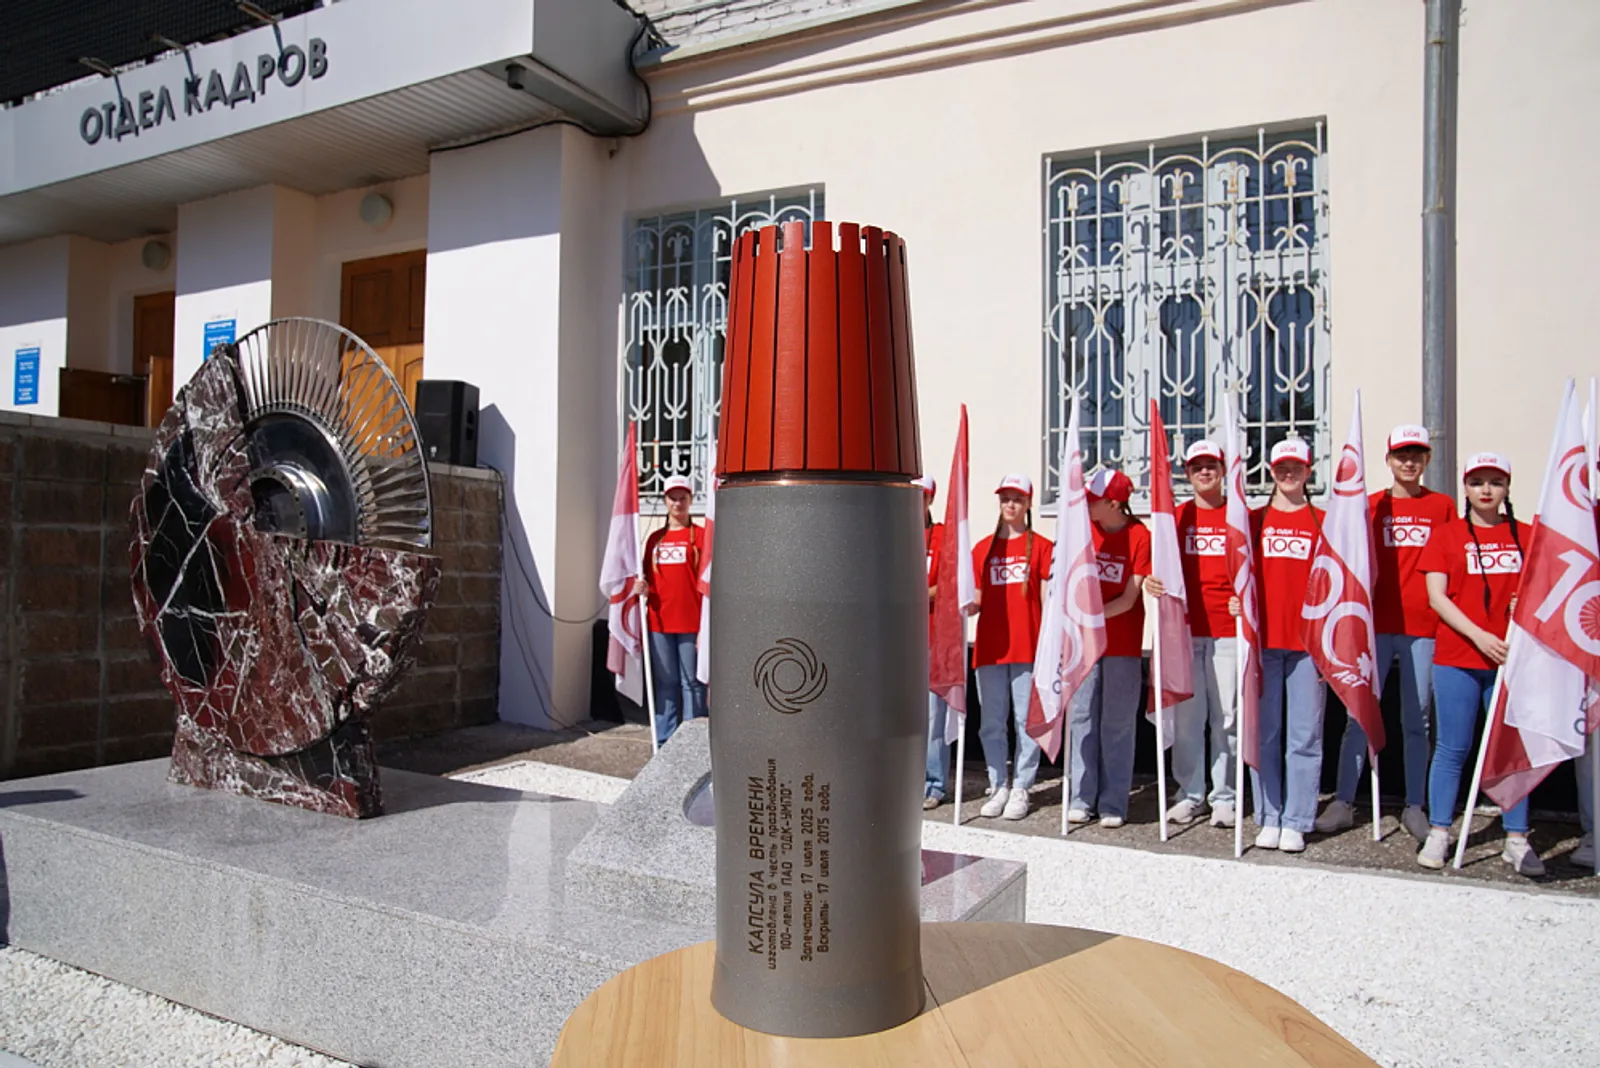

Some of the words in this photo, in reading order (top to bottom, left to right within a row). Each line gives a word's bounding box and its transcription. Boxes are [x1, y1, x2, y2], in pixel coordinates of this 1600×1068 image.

[80, 84, 176, 145] ОТДЕЛ
[184, 37, 328, 117] КАДРОВ
[766, 758, 778, 838] празднования
[748, 776, 765, 860] ВРЕМЕНИ
[801, 807, 814, 834] 2025
[817, 818, 830, 844] 2075
[768, 843, 778, 878] честь
[803, 840, 814, 867] июля
[818, 850, 830, 877] июля
[781, 861, 793, 886] ПАО
[801, 872, 814, 884] 17
[817, 883, 830, 894] 17
[748, 870, 765, 955] КАПСУЛА
[780, 891, 793, 951] 100-летия
[817, 899, 831, 953] Вскрыть:
[766, 895, 777, 970] изготовлена
